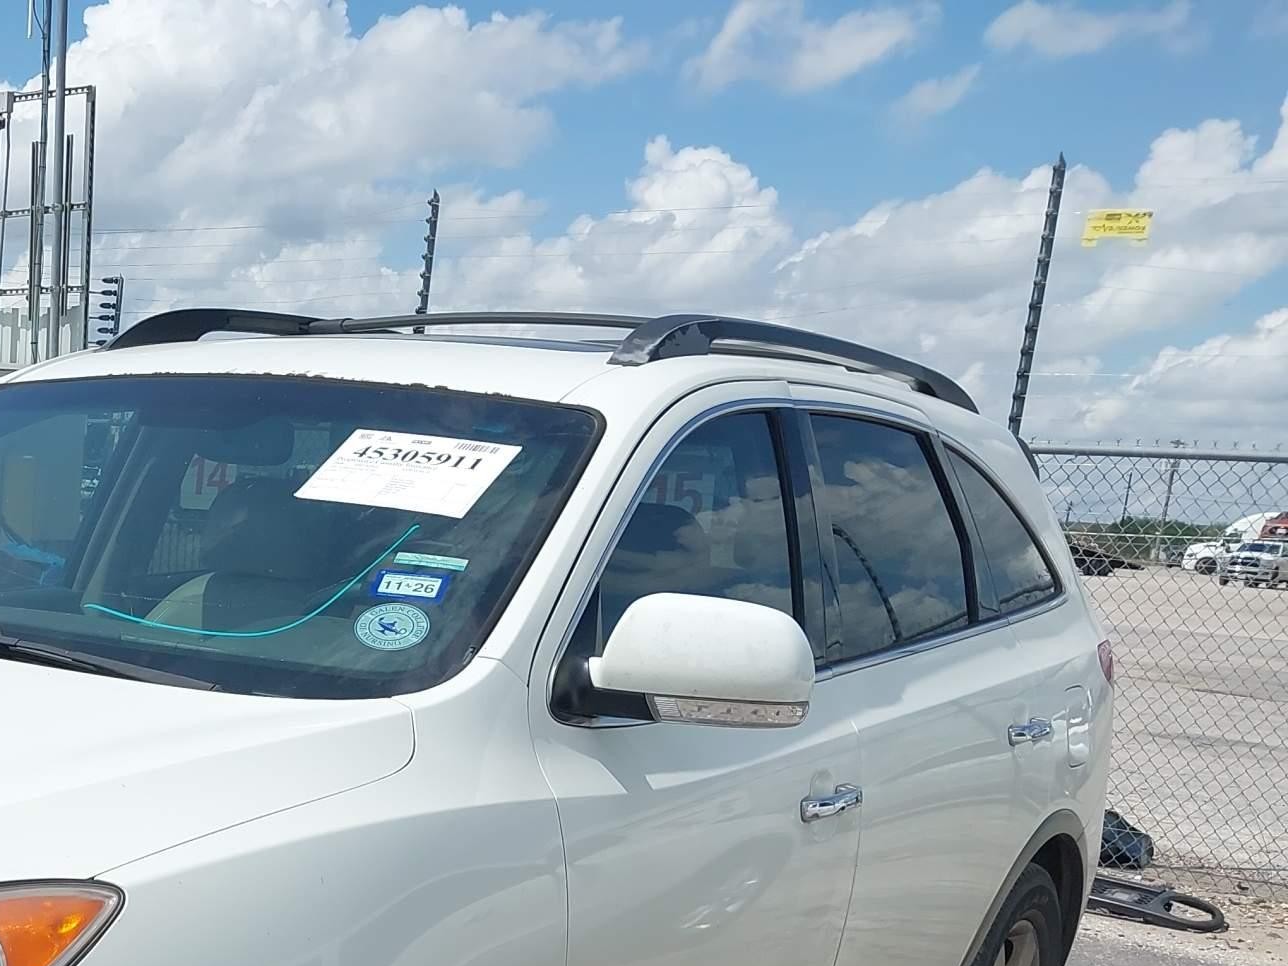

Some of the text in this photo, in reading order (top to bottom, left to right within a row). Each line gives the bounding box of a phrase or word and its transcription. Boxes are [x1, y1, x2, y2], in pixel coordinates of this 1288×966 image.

[353, 445, 484, 471] 45305911
[406, 609, 425, 640] COLLEGE
[360, 631, 403, 647] NURSING
